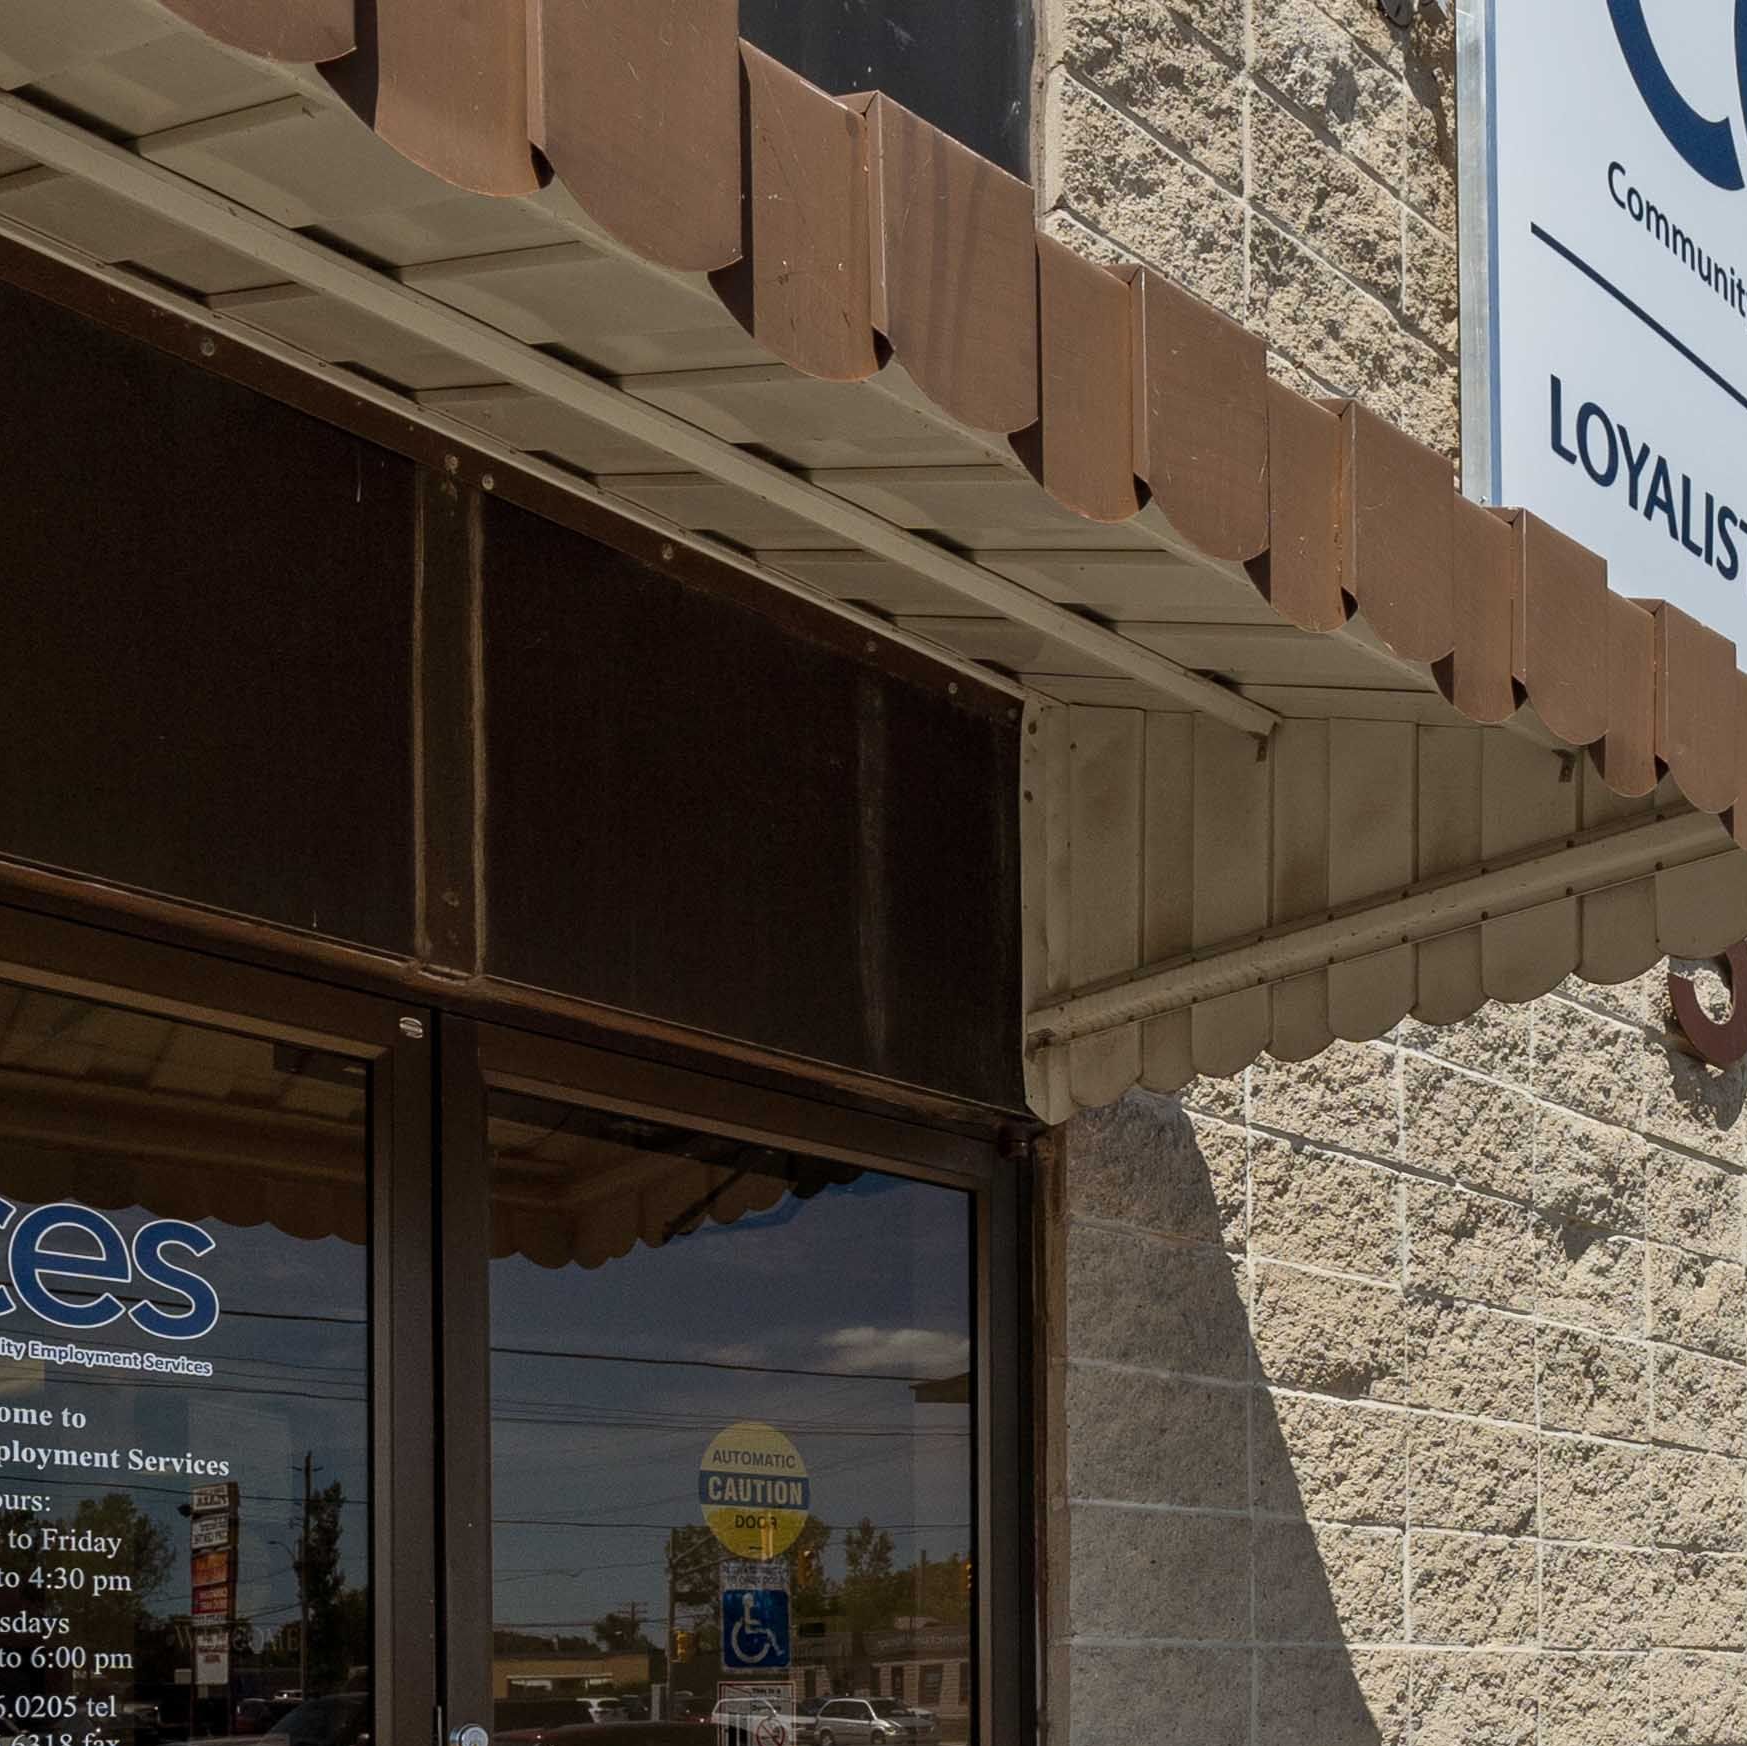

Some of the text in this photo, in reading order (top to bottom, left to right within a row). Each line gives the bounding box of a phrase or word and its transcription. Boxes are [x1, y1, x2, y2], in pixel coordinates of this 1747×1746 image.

[28, 1341, 142, 1368] Employment
[143, 1353, 213, 1377] Services
[61, 1406, 87, 1429] to
[127, 1448, 230, 1476] Services
[712, 1449, 796, 1469] AUTOMATIC
[708, 1476, 803, 1505] CAUTION
[7, 1526, 32, 1551] to
[40, 1527, 122, 1558] Friday
[28, 1566, 85, 1591] 4:30
[92, 1574, 132, 1597] pm
[30, 1646, 86, 1669] 6:00
[93, 1652, 134, 1675] pm
[85, 1695, 117, 1718] tel
